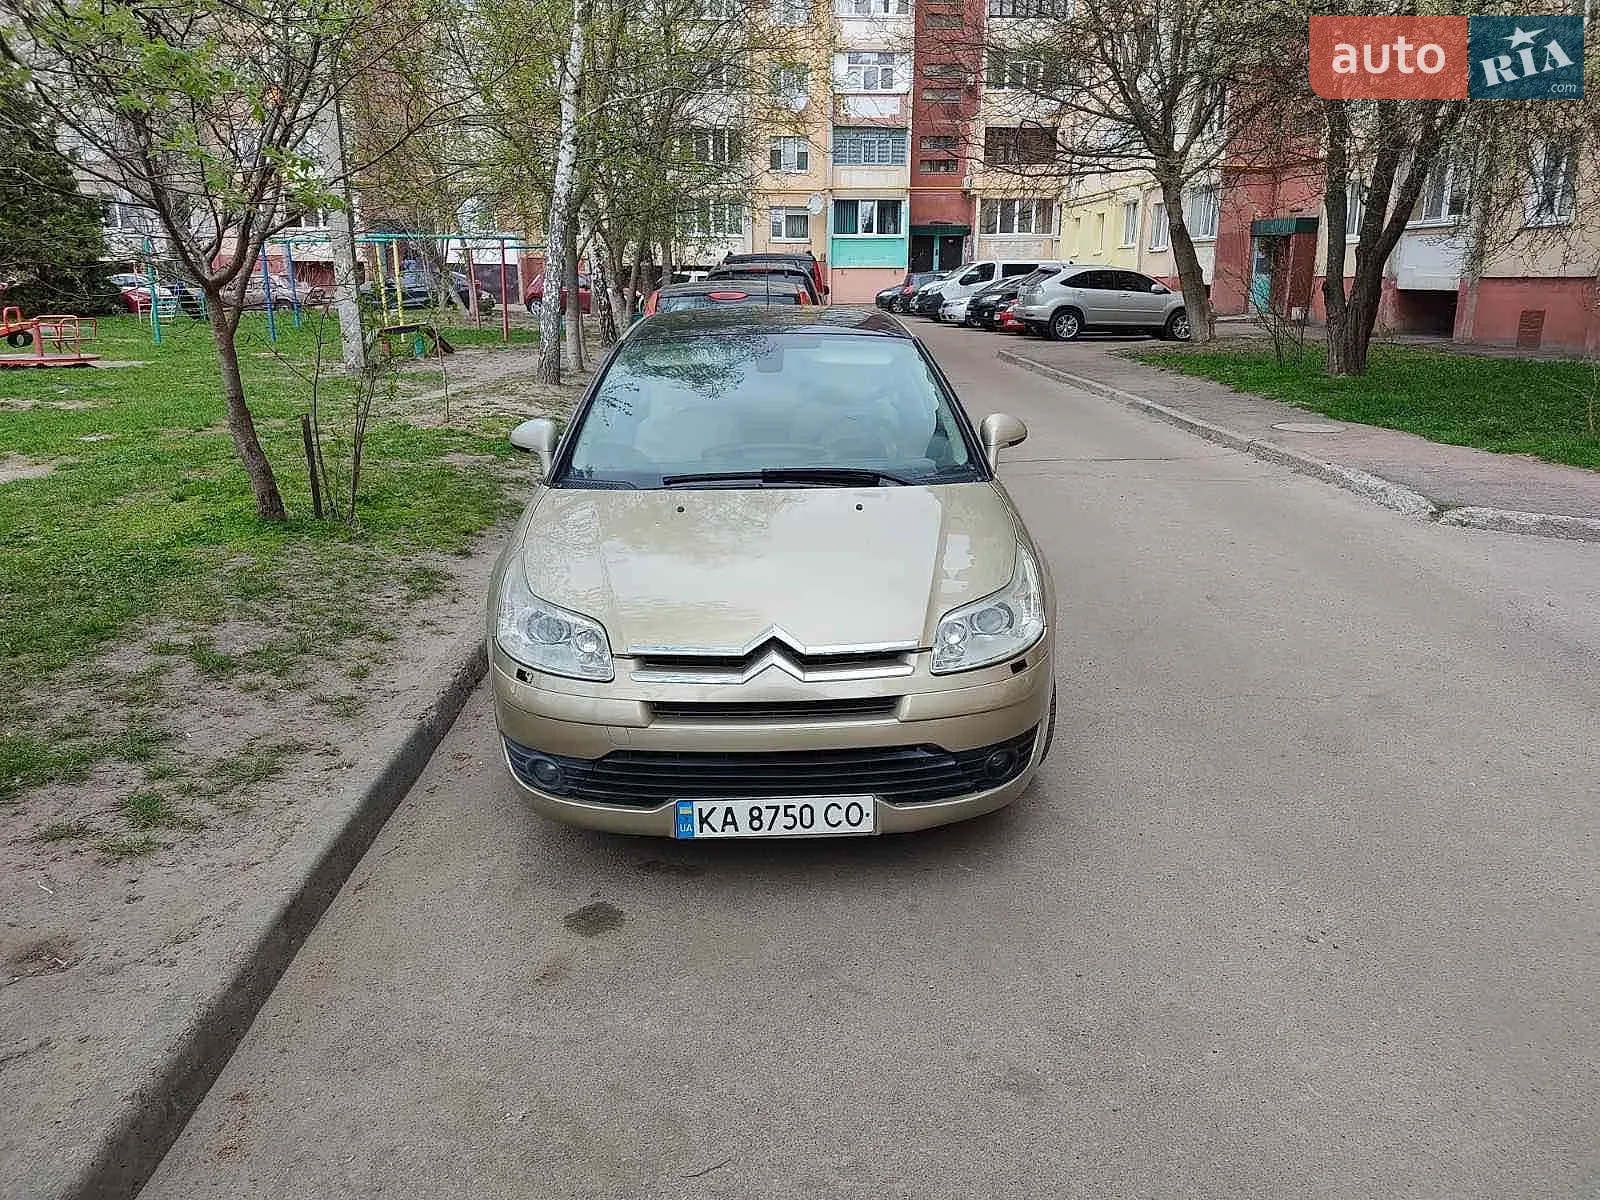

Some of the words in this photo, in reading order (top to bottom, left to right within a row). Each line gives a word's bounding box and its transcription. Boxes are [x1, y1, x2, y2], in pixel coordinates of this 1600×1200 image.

[679, 823, 693, 832] UA
[698, 807, 739, 833] KA
[748, 804, 815, 831] 8750
[823, 802, 864, 827] CO
